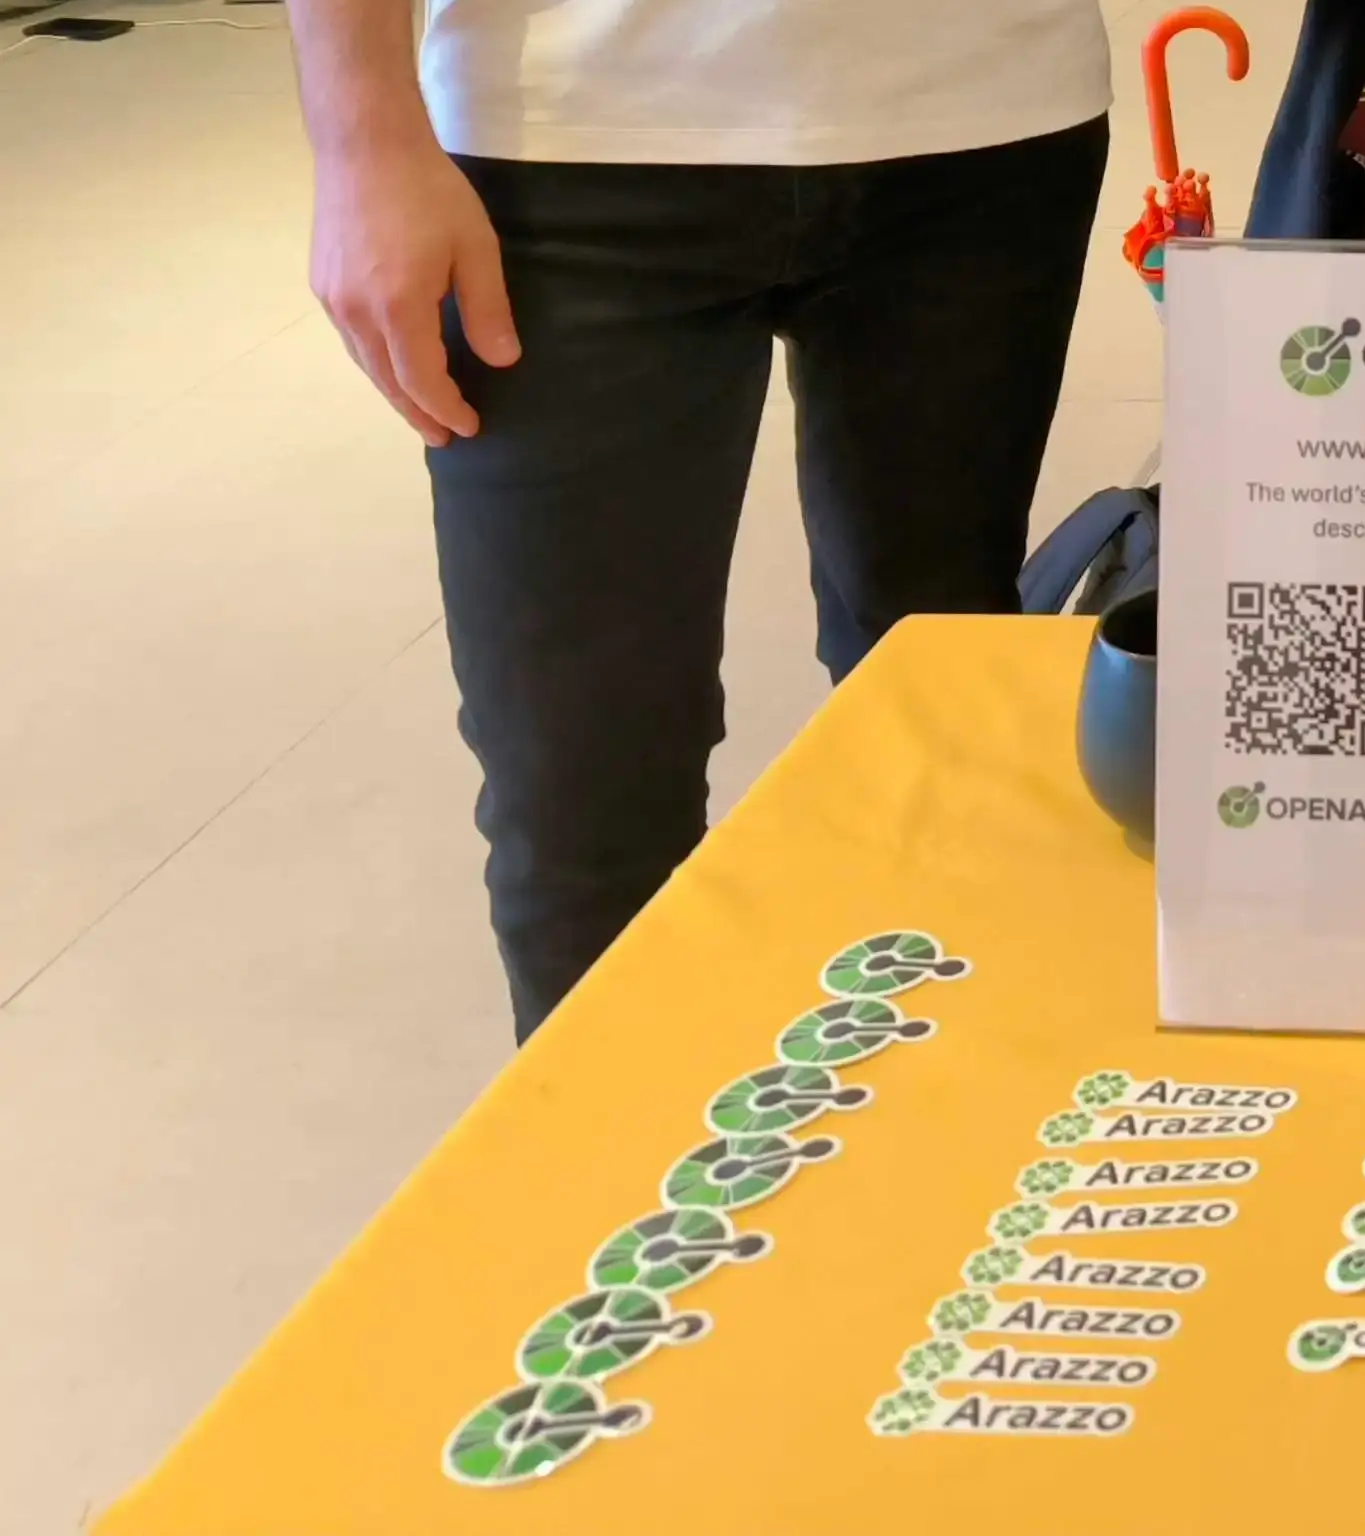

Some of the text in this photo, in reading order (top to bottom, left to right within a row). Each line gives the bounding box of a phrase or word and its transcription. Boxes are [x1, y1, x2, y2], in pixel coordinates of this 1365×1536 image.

[1245, 483, 1286, 505] The
[1137, 1080, 1292, 1109] Arazzo
[1105, 1113, 1267, 1138] Arazzo
[1085, 1161, 1252, 1186] Arazzo
[1060, 1203, 1231, 1231] Arazzo
[1029, 1255, 1200, 1290] Arazzo
[1000, 1301, 1174, 1336] Arazzo
[969, 1348, 1149, 1384] Arazzo
[943, 1396, 1128, 1432] Arazzo
